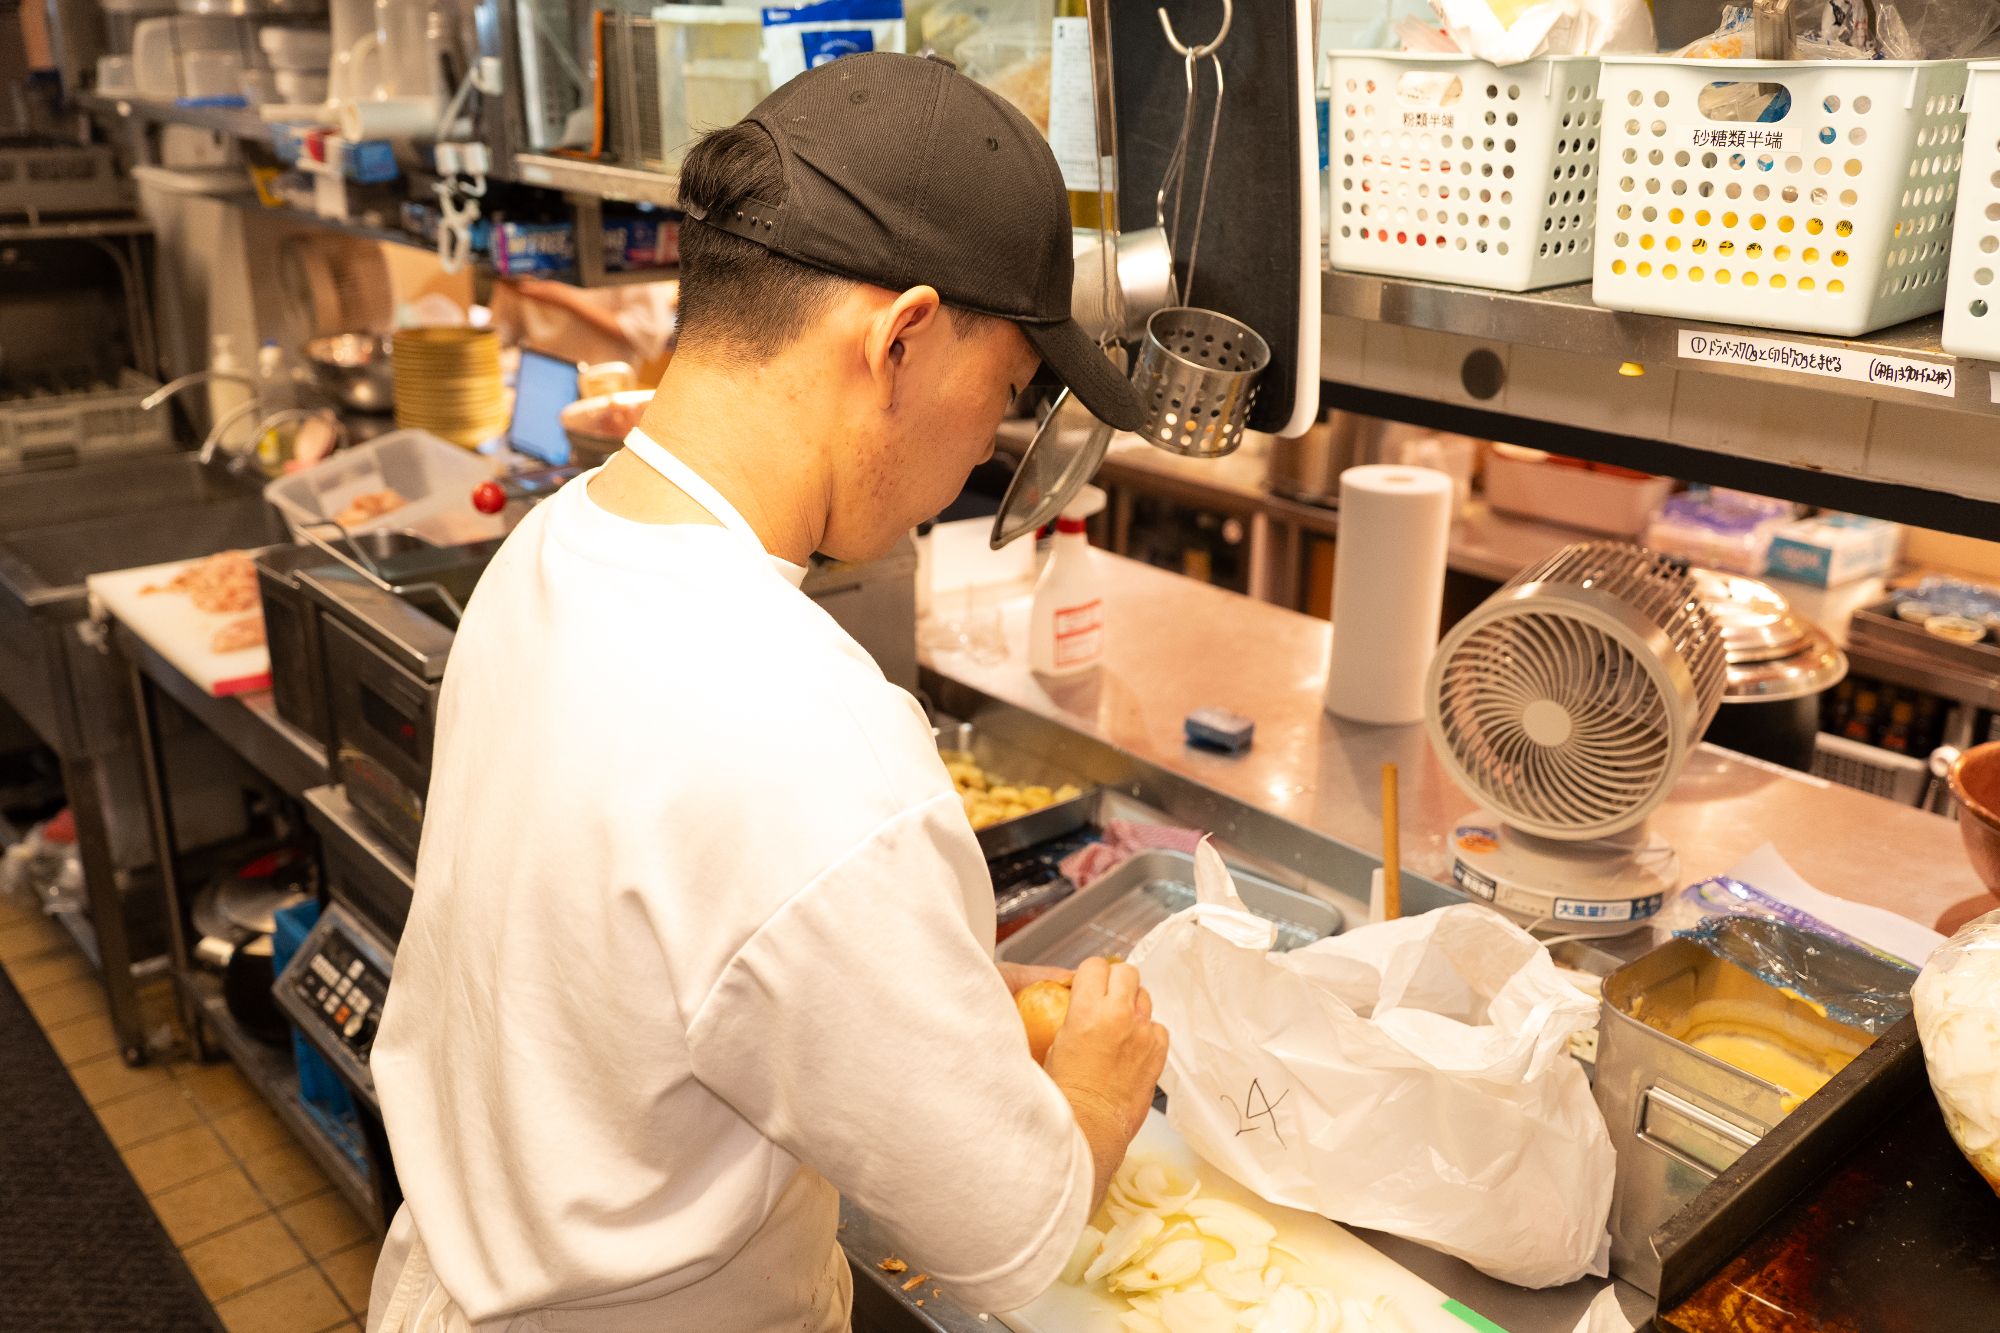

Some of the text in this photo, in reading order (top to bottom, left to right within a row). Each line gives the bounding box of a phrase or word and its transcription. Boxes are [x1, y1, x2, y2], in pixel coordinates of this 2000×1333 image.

[1403, 112, 1455, 129] 粉類半端
[1692, 129, 1784, 150] 砂糖類半端
